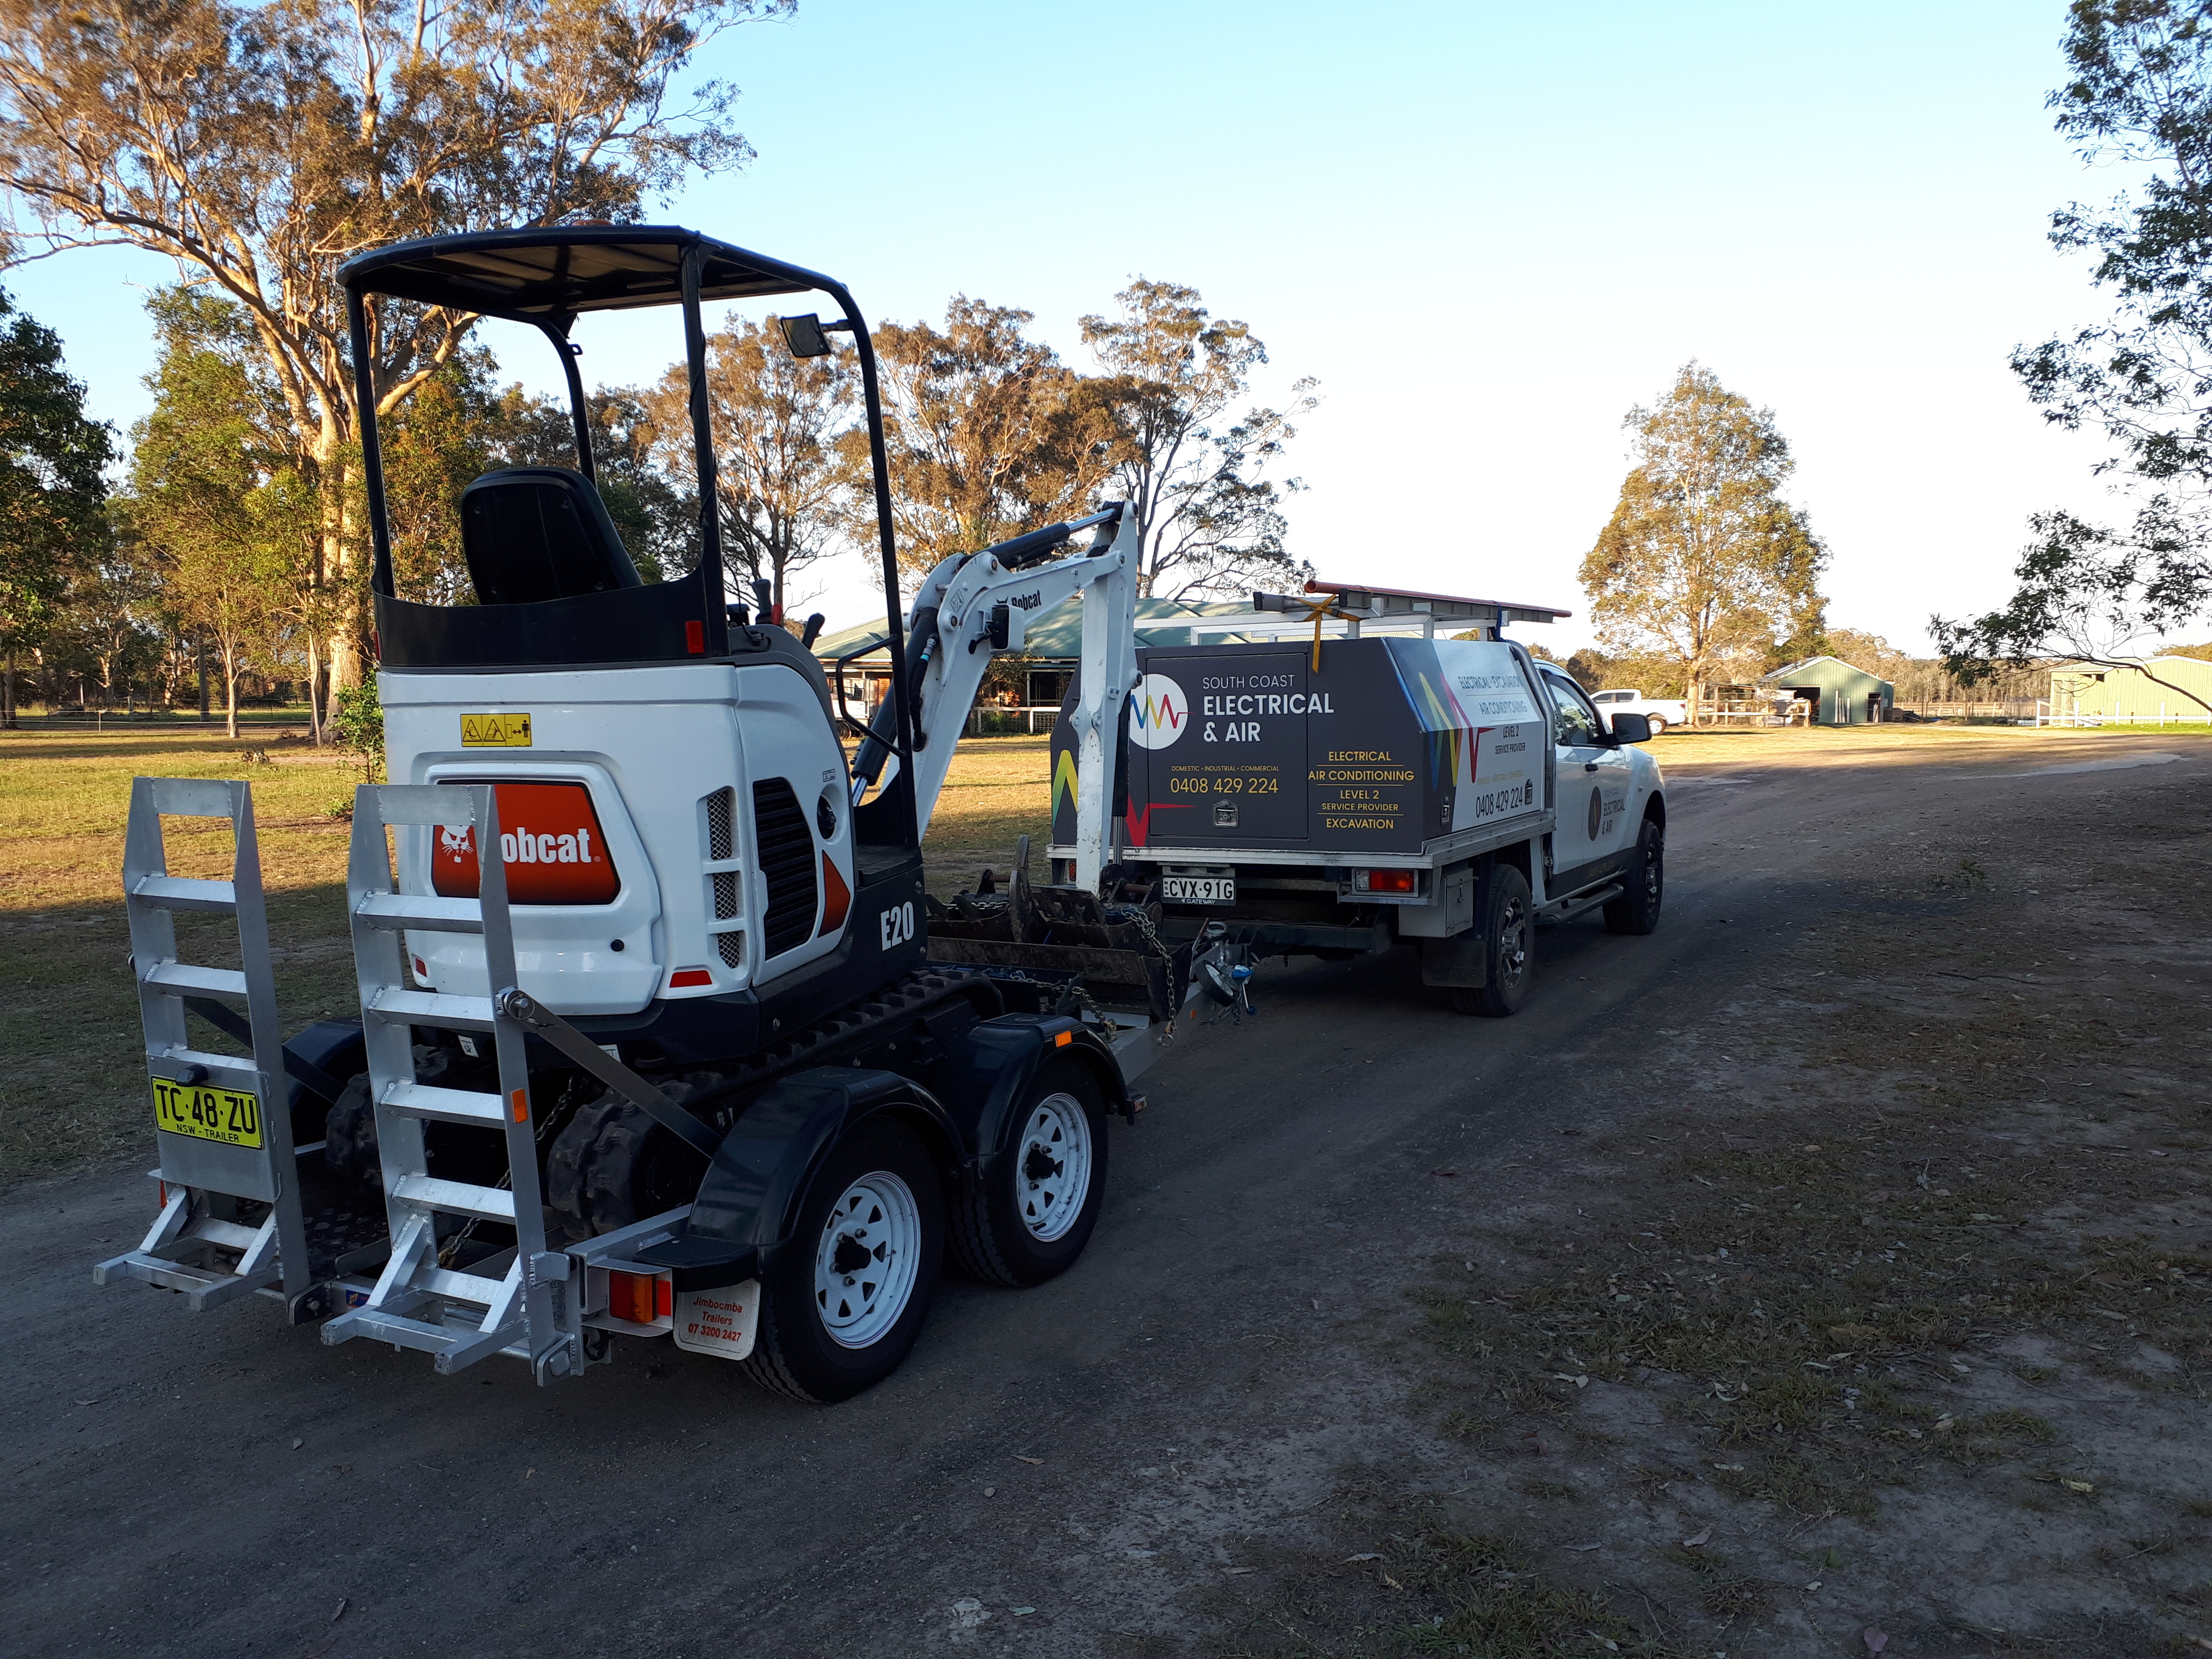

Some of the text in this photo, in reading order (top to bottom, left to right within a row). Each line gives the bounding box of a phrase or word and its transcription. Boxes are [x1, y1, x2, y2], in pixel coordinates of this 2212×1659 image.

[1011, 589, 1042, 611] Bobcat
[1202, 674, 1295, 689] SOUTH COAST
[1457, 676, 1491, 689] ELECTRICAL
[1203, 693, 1334, 716] ELECTRICAL
[1479, 700, 1527, 715] AIR CONDITIONING
[1203, 721, 1261, 742] & AIR
[1503, 725, 1519, 738] LEVEL 2
[1329, 751, 1392, 761] ELECTRICAL
[1495, 742, 1526, 755] SERVICE PROVIDER
[1308, 770, 1415, 781] AIR CONDITIONING
[1170, 778, 1279, 793] 0408 429 224
[1340, 790, 1379, 799] LEVEL 2
[1476, 786, 1523, 818] 0408 429 224
[1326, 818, 1394, 829] EXCAVATION
[501, 827, 591, 863] obcat
[880, 901, 914, 951] E20
[177, 1123, 195, 1134] NSW
[204, 1129, 240, 1143] TRAILER
[702, 1311, 733, 1325] Trailers
[688, 1323, 699, 1334] 07
[700, 1325, 720, 1338] 3200
[722, 1329, 742, 1342] 2427
